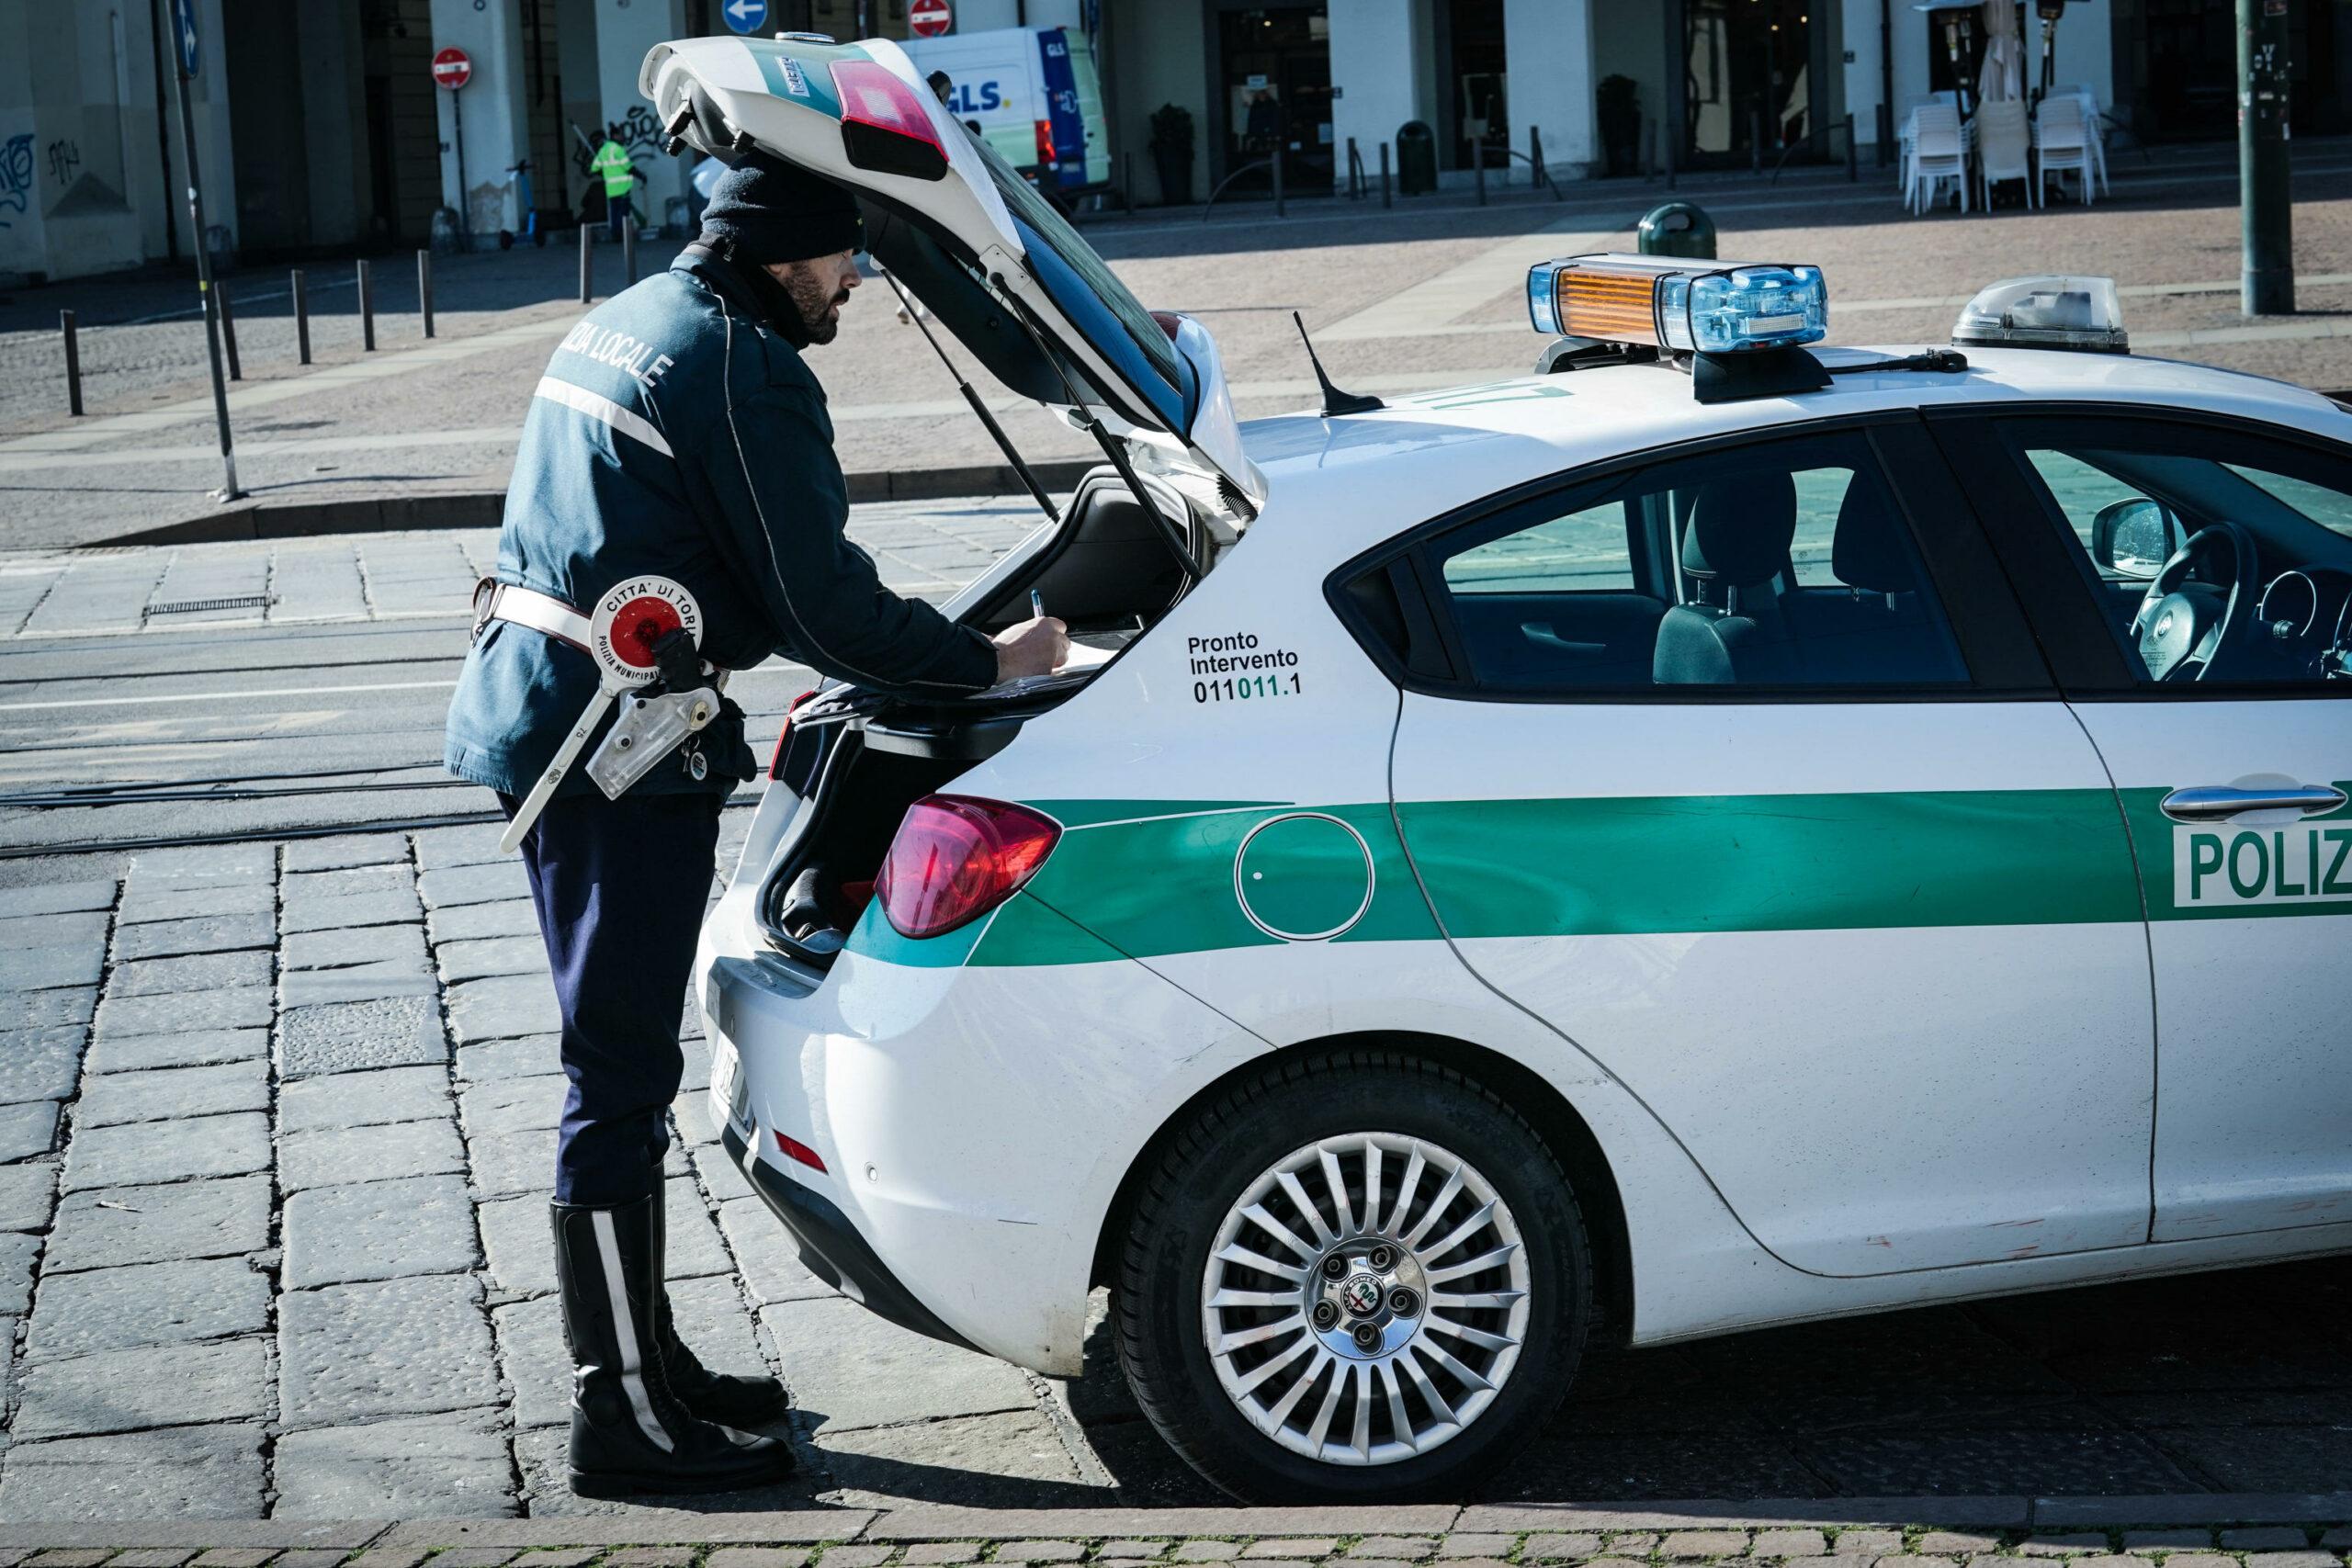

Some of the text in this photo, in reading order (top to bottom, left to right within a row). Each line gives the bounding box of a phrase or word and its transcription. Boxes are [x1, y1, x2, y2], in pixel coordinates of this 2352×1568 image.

[1046, 43, 1066, 57] GLS
[589, 329, 674, 388] LOCALE
[657, 584, 674, 598] DI
[598, 635, 616, 667] POLIZIA
[1188, 631, 1259, 654] Pronto
[1190, 649, 1298, 675] Intervento
[1193, 671, 1301, 704] 011011.1
[2190, 829, 2352, 900] POLIZ
